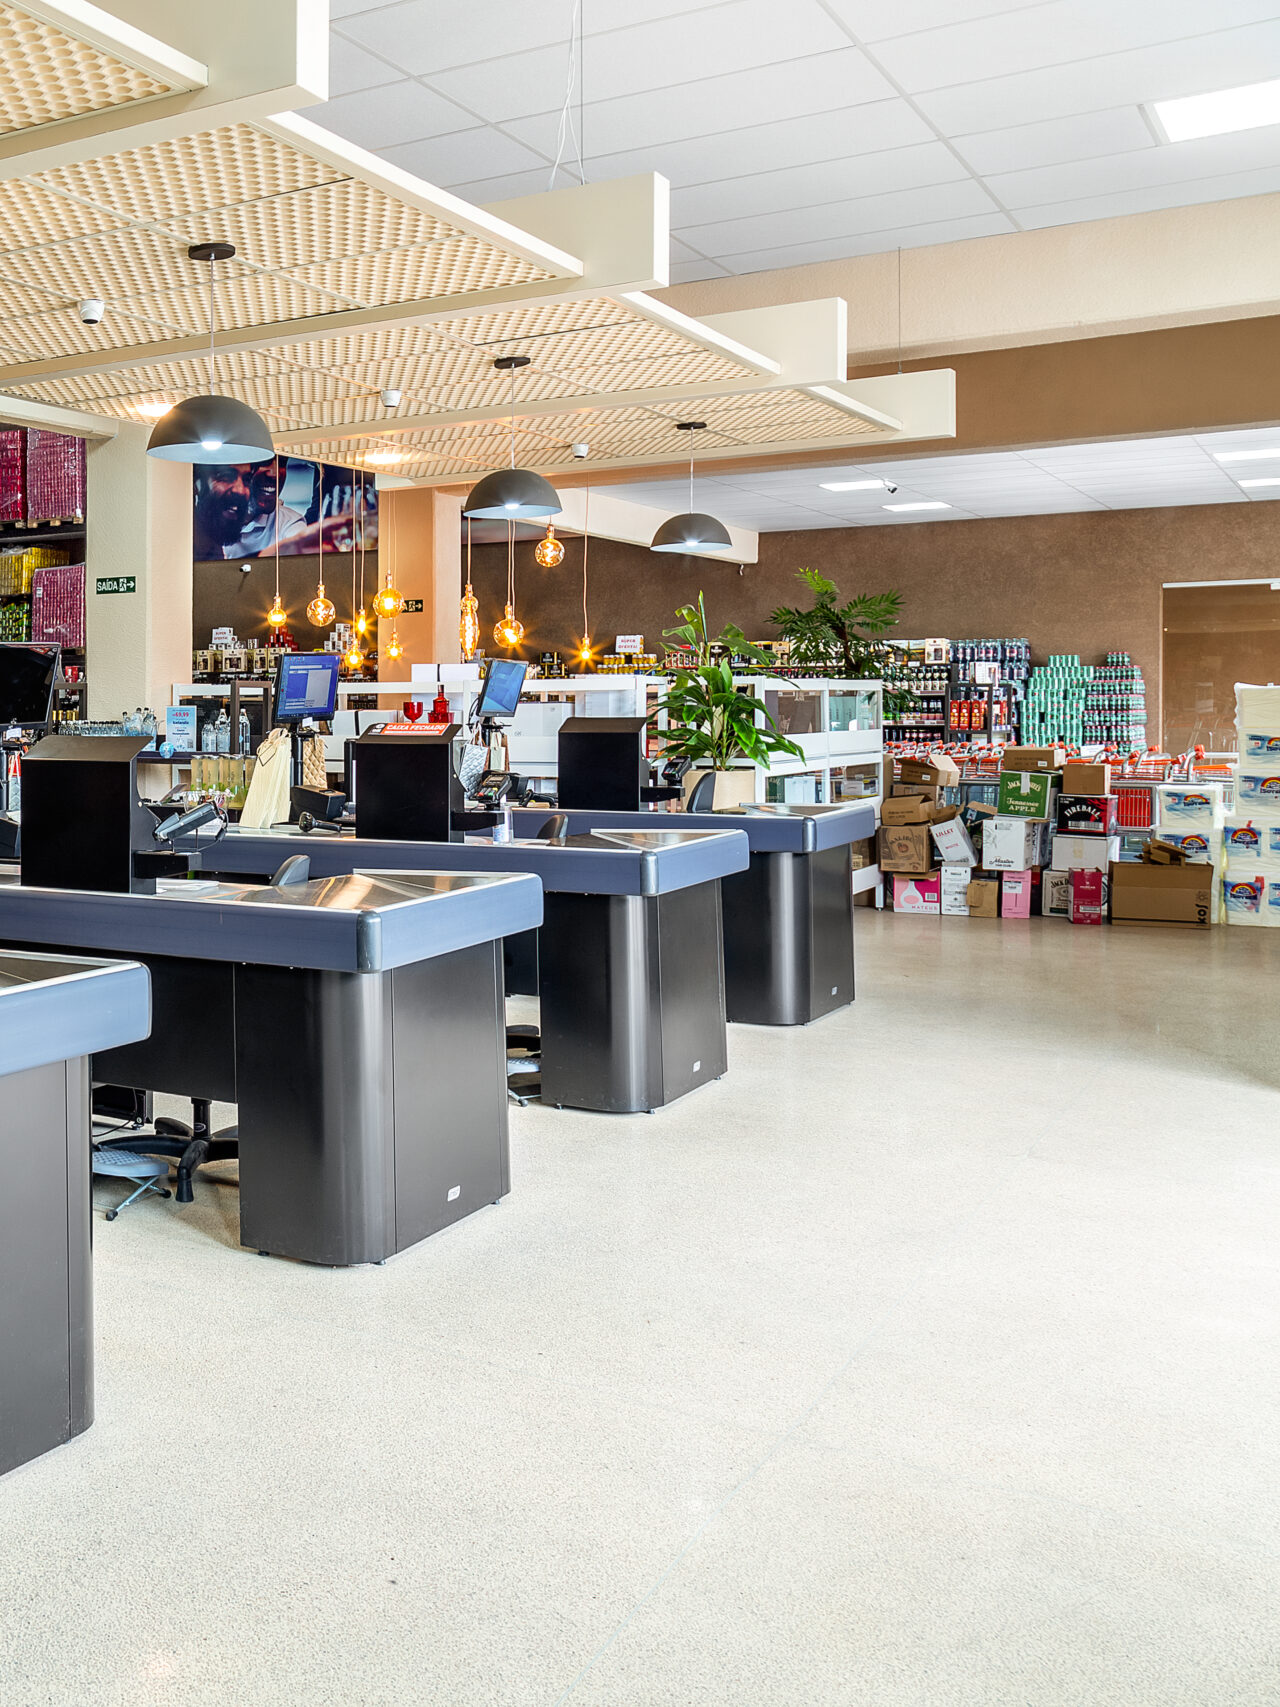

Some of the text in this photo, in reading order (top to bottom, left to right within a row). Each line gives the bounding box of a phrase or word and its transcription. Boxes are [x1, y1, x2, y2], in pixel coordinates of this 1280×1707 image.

[97, 578, 118, 591] SAÍDA
[1007, 780, 1021, 789] JACK
[1008, 804, 1036, 812] APPLE
[1064, 804, 1101, 820] FIREBALL
